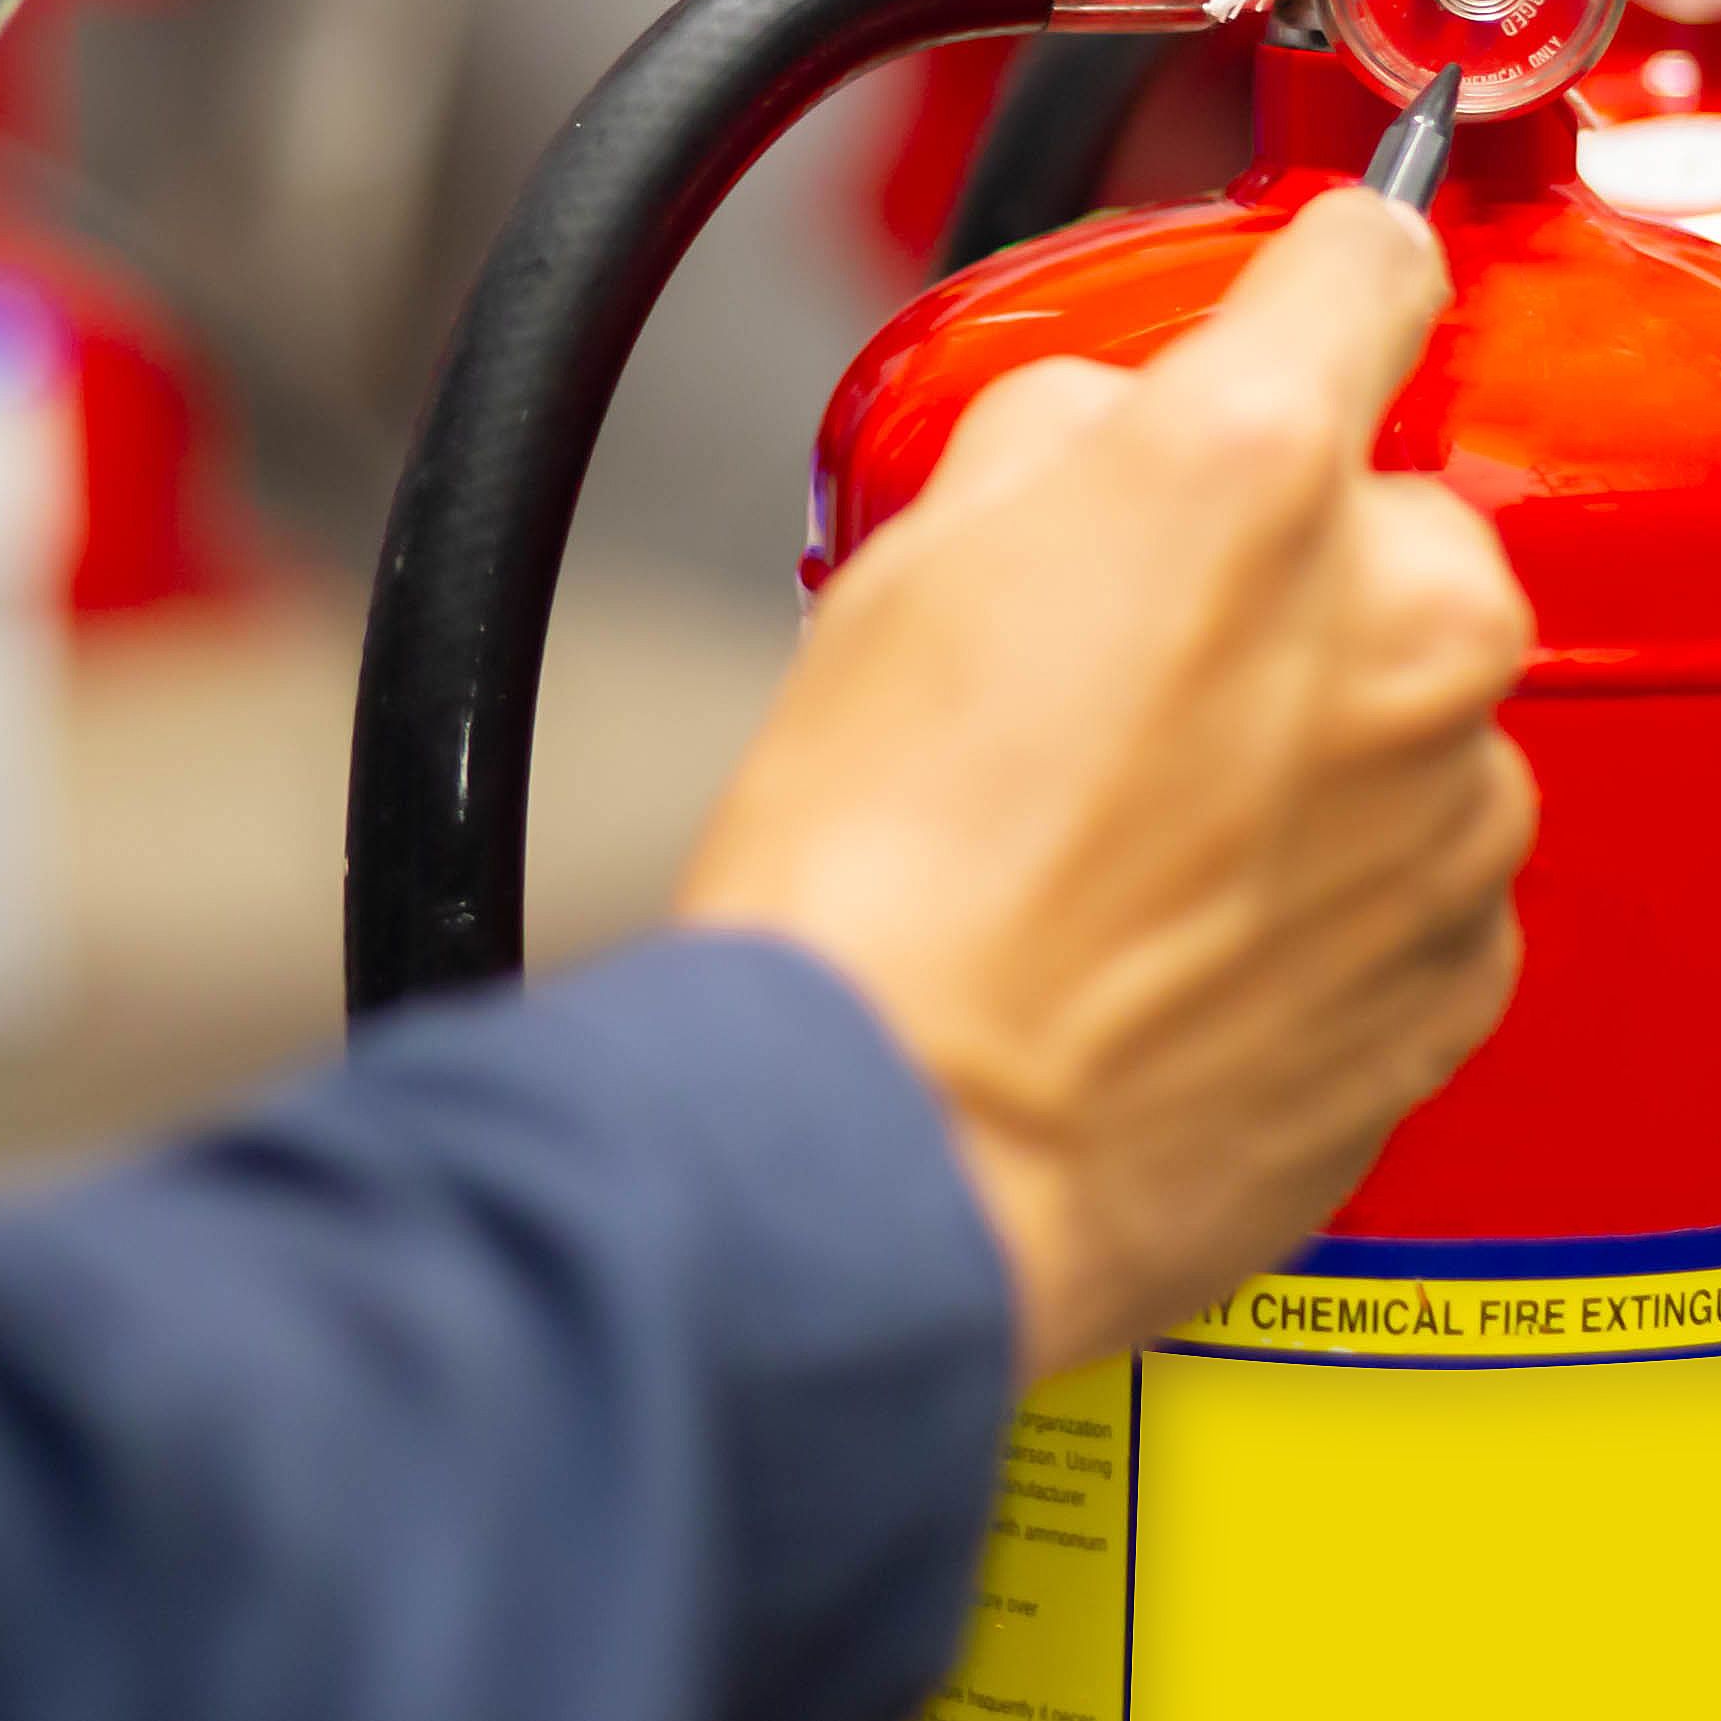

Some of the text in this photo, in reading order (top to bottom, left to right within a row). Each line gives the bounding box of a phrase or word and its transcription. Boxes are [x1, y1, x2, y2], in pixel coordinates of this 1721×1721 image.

[1528, 35, 1562, 69] ONLY
[1251, 1292, 1464, 1336] CHEMICAL
[1480, 1298, 1566, 1336] FIRE
